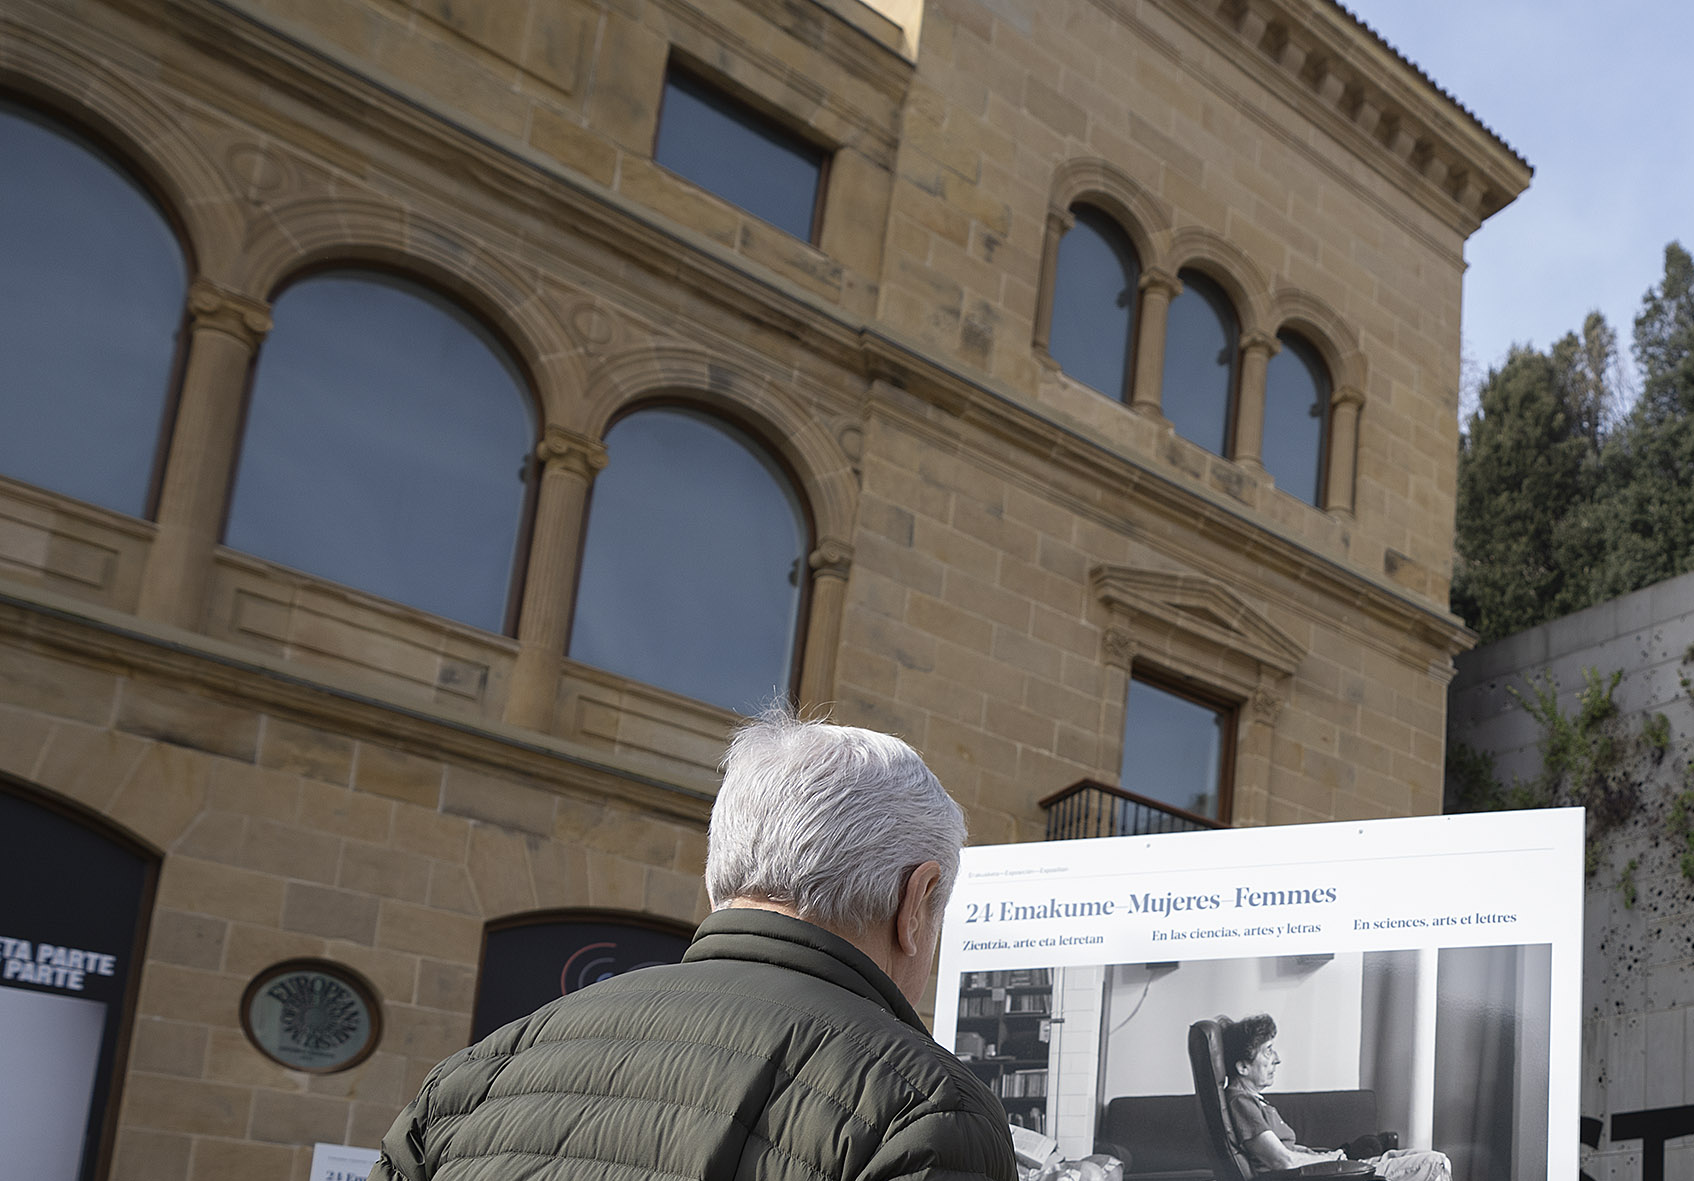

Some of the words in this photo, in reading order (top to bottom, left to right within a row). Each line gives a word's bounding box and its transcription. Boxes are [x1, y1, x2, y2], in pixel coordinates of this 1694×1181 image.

[966, 903, 993, 923] 24
[1354, 919, 1370, 930] En
[1373, 917, 1429, 930] sciences,
[1432, 915, 1457, 926] arts
[1460, 915, 1472, 925] et
[1476, 912, 1517, 924] lettres
[1152, 930, 1167, 941] En
[1171, 929, 1187, 940] las
[1190, 927, 1240, 939] ciencias,
[1244, 926, 1274, 937] artes
[1276, 926, 1284, 937] y
[1287, 923, 1321, 934] letras
[963, 939, 1011, 951] Zientzia,
[1013, 936, 1036, 948] arte
[1039, 936, 1056, 947] eta
[1059, 935, 1104, 946] letretan
[36, 943, 116, 976] PARTE
[3, 960, 85, 991] PARTE
